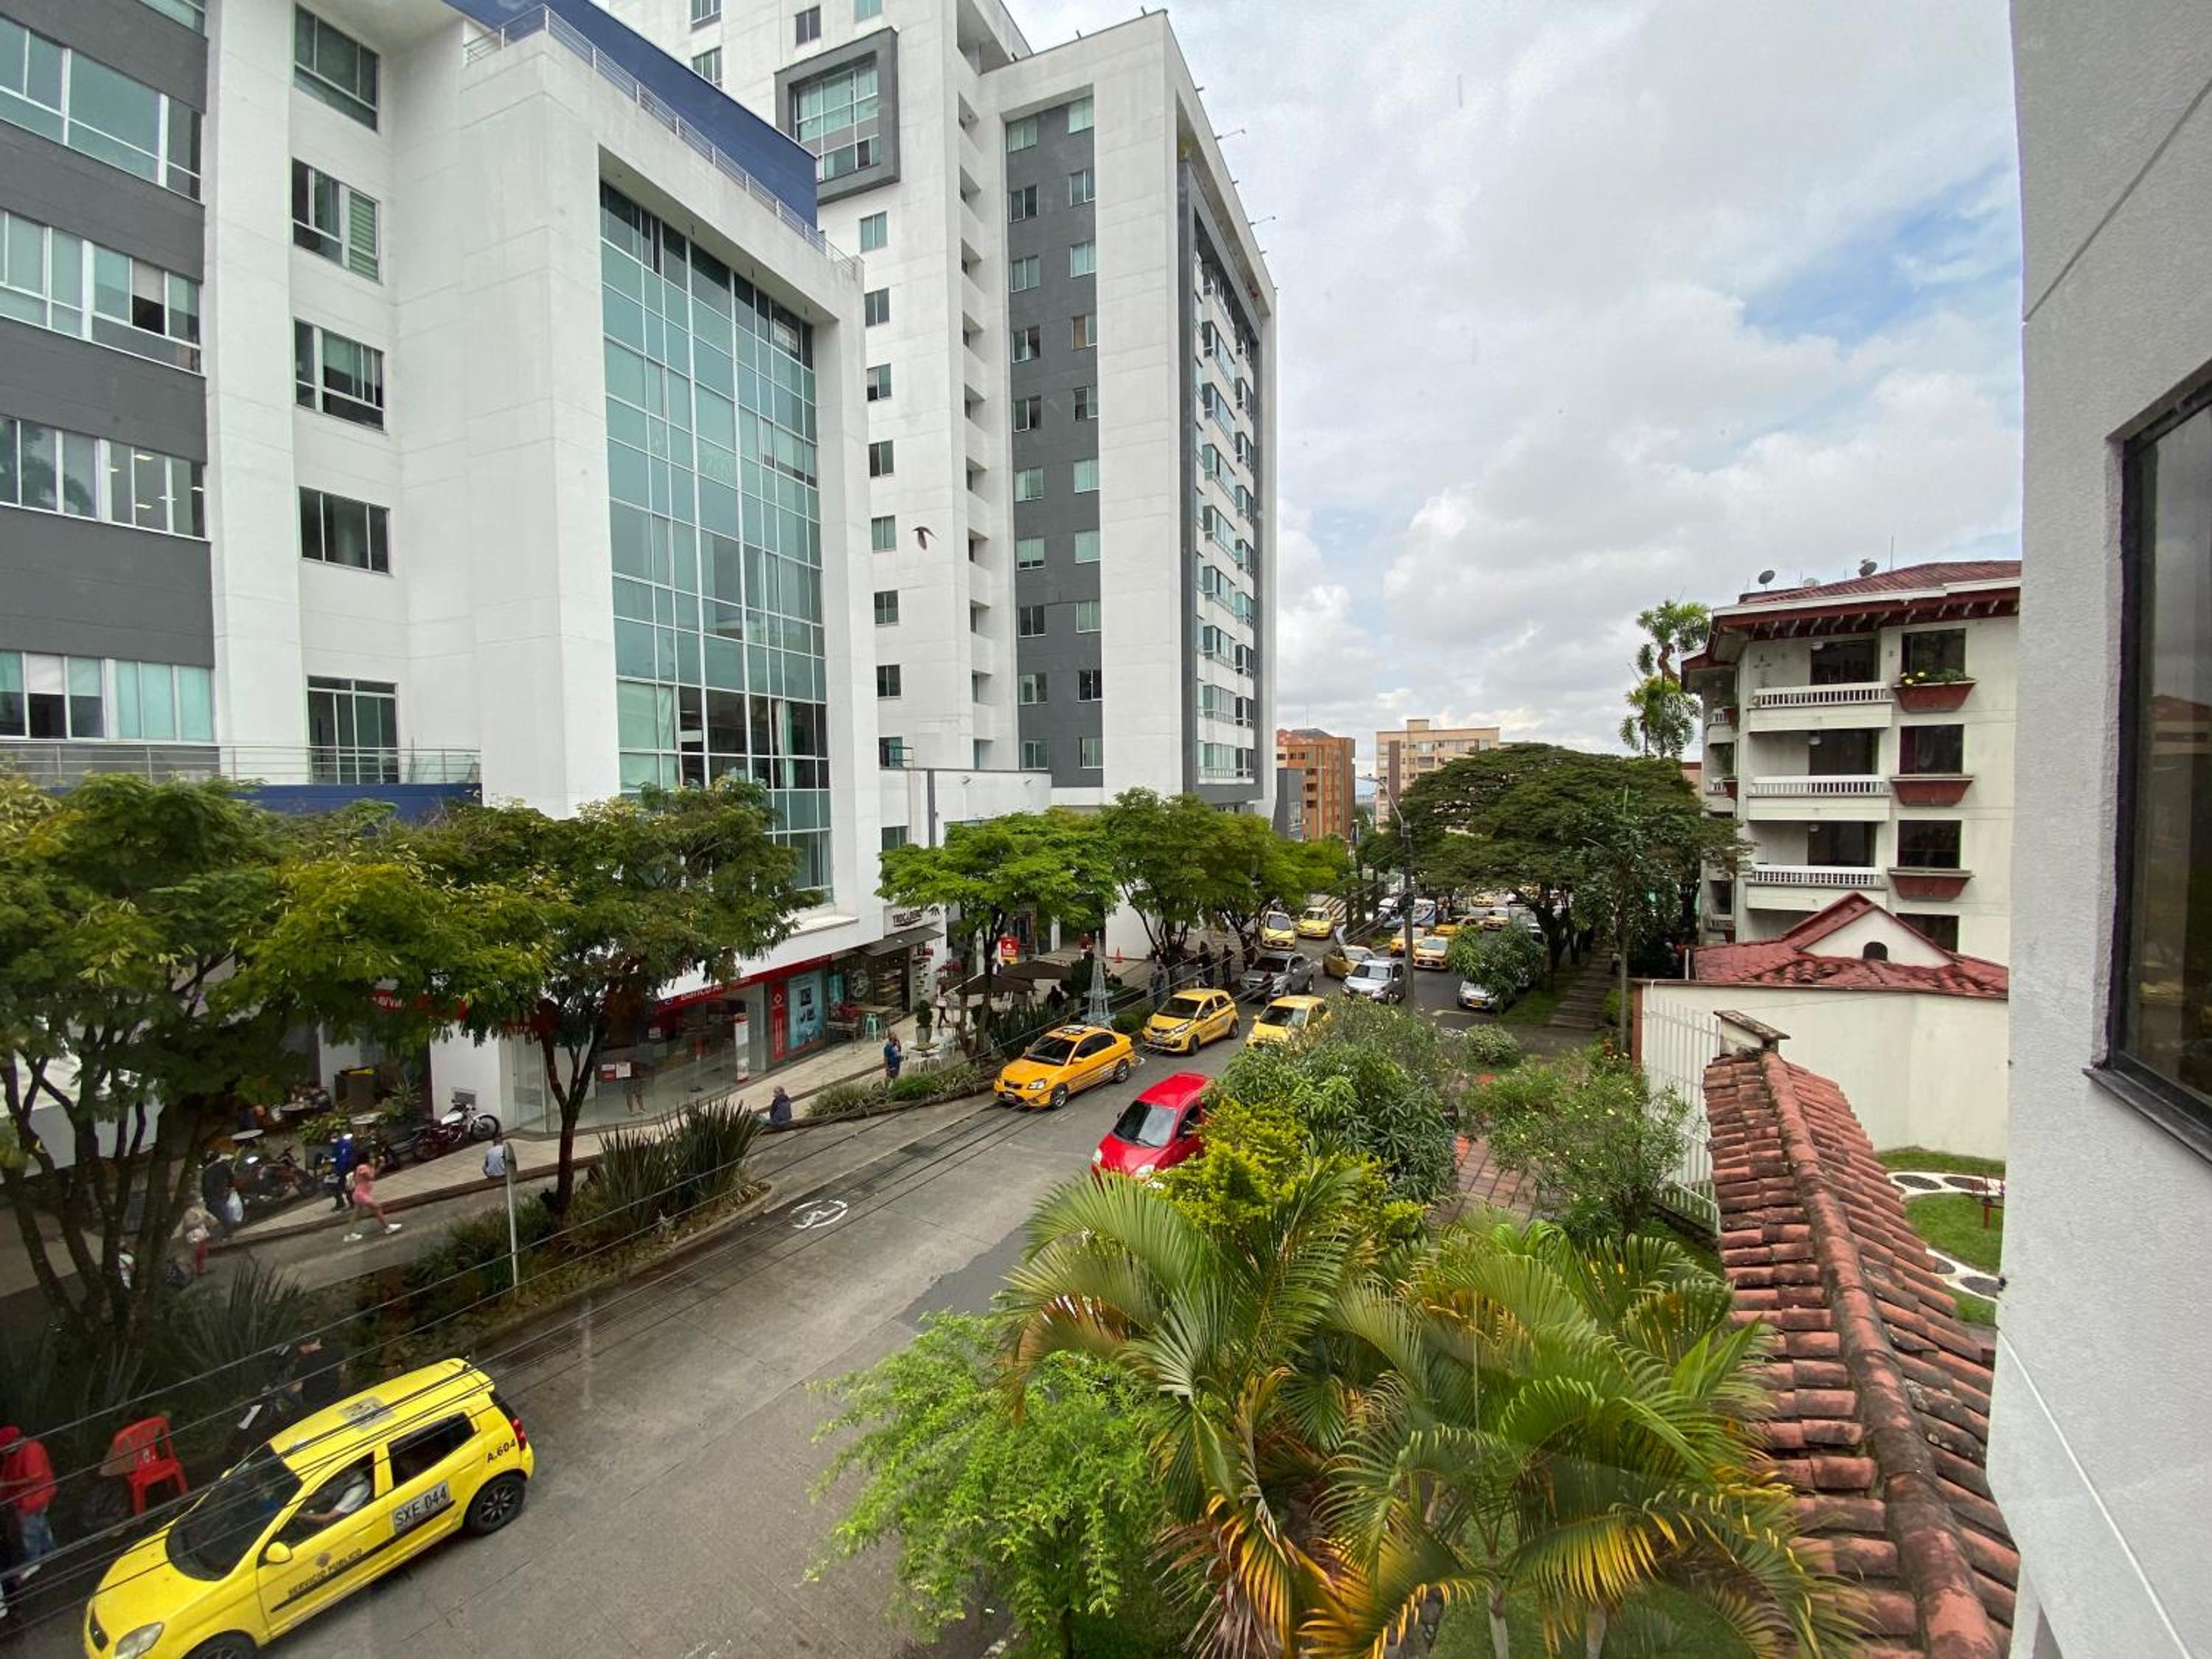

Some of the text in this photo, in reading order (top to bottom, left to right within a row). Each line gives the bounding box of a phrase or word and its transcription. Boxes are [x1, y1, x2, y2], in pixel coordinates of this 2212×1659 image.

[487, 1439, 516, 1464] A.604
[394, 1485, 448, 1527] SXE 044
